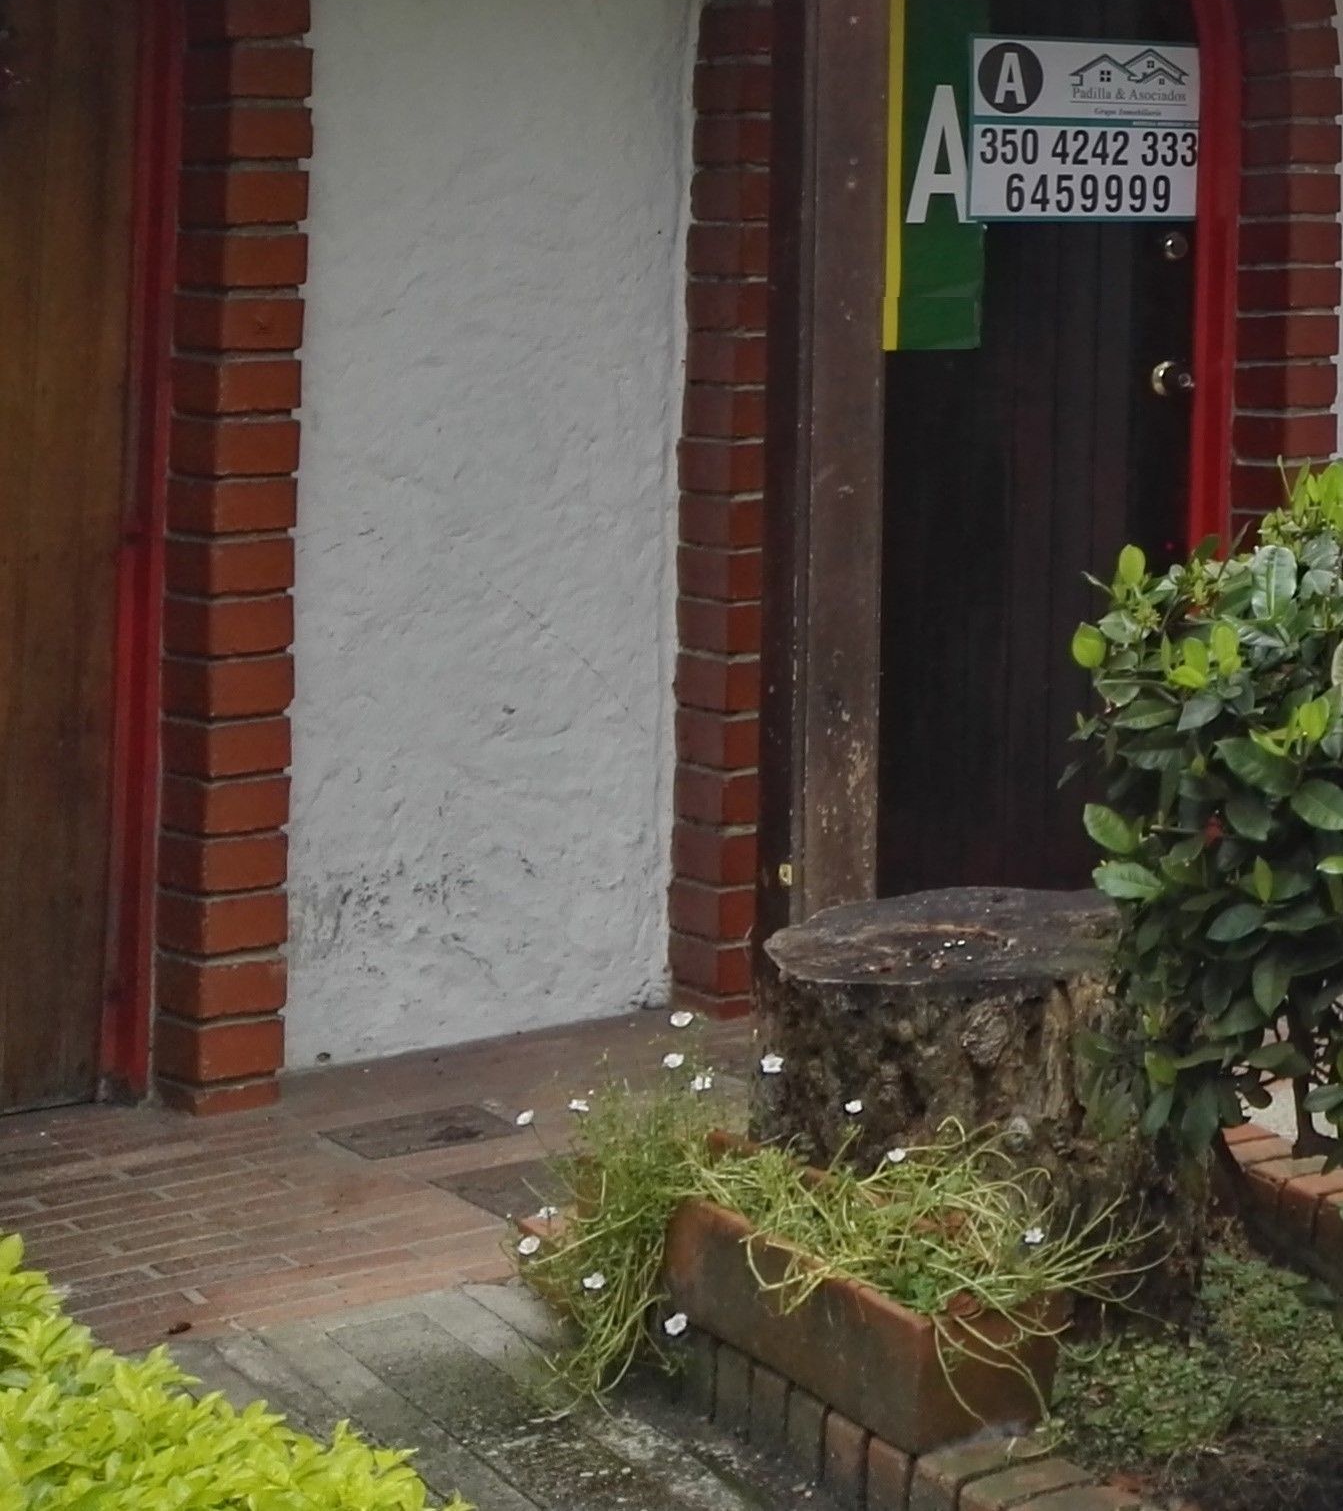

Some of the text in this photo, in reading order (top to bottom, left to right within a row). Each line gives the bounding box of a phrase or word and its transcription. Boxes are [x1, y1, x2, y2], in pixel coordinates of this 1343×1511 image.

[994, 52, 1028, 105] A
[1072, 87, 1187, 102] Padilla & Asociados
[979, 127, 1197, 167] 350 4242 333
[1005, 173, 1172, 213] 6459999
